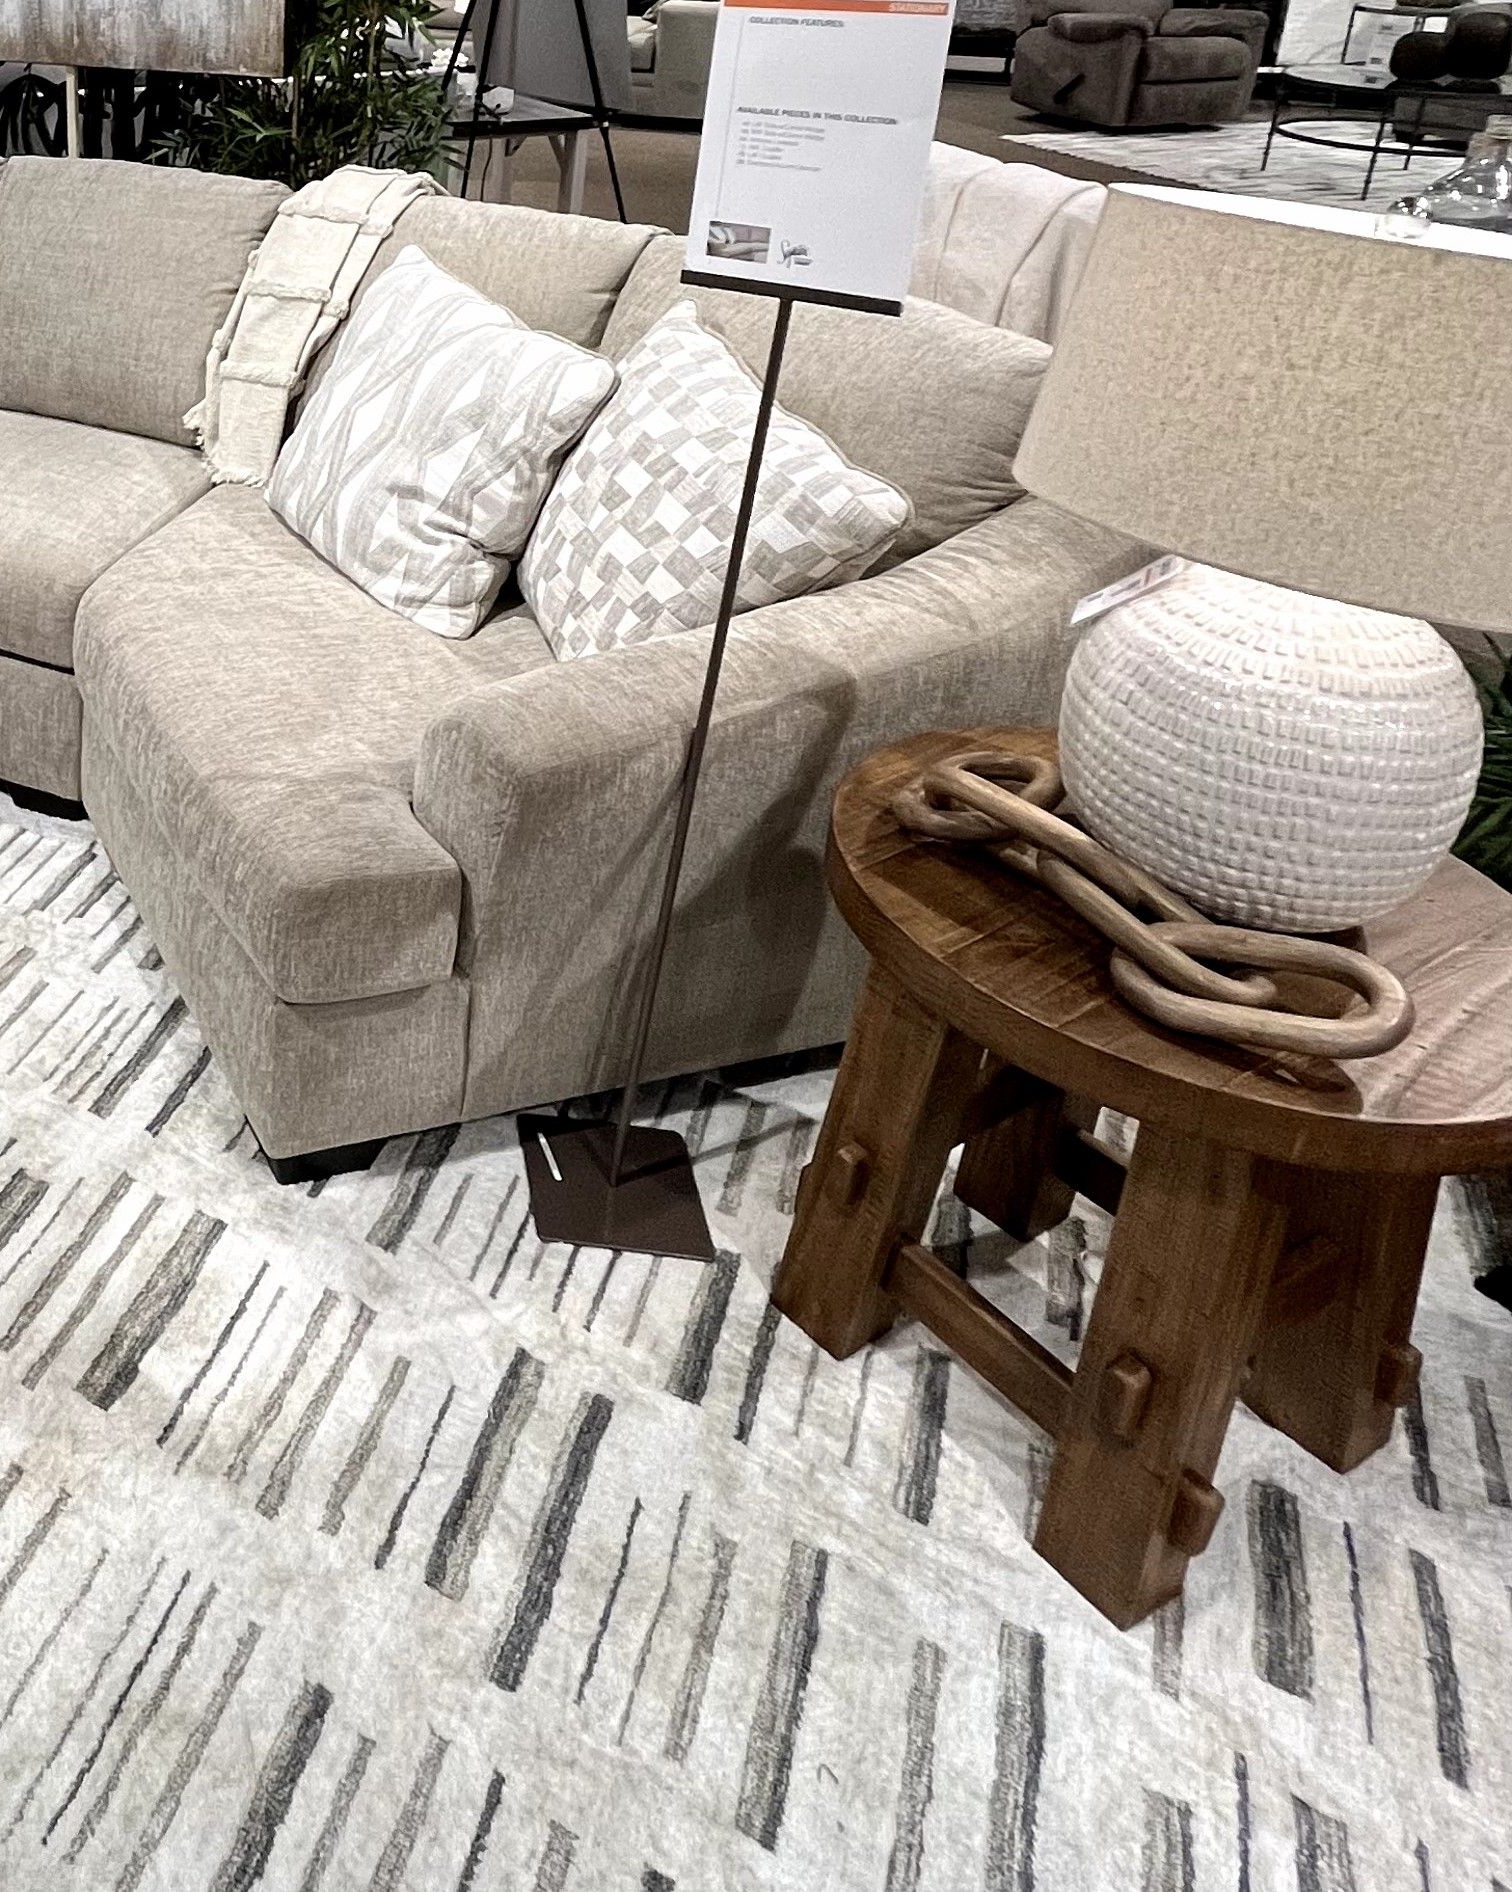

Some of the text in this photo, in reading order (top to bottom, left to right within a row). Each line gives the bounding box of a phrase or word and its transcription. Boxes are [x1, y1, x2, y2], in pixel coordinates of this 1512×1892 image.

[750, 16, 798, 25] COLLECTION
[737, 106, 780, 116] AVAILABLE
[782, 109, 810, 118] PIECES
[824, 112, 842, 120] THIS
